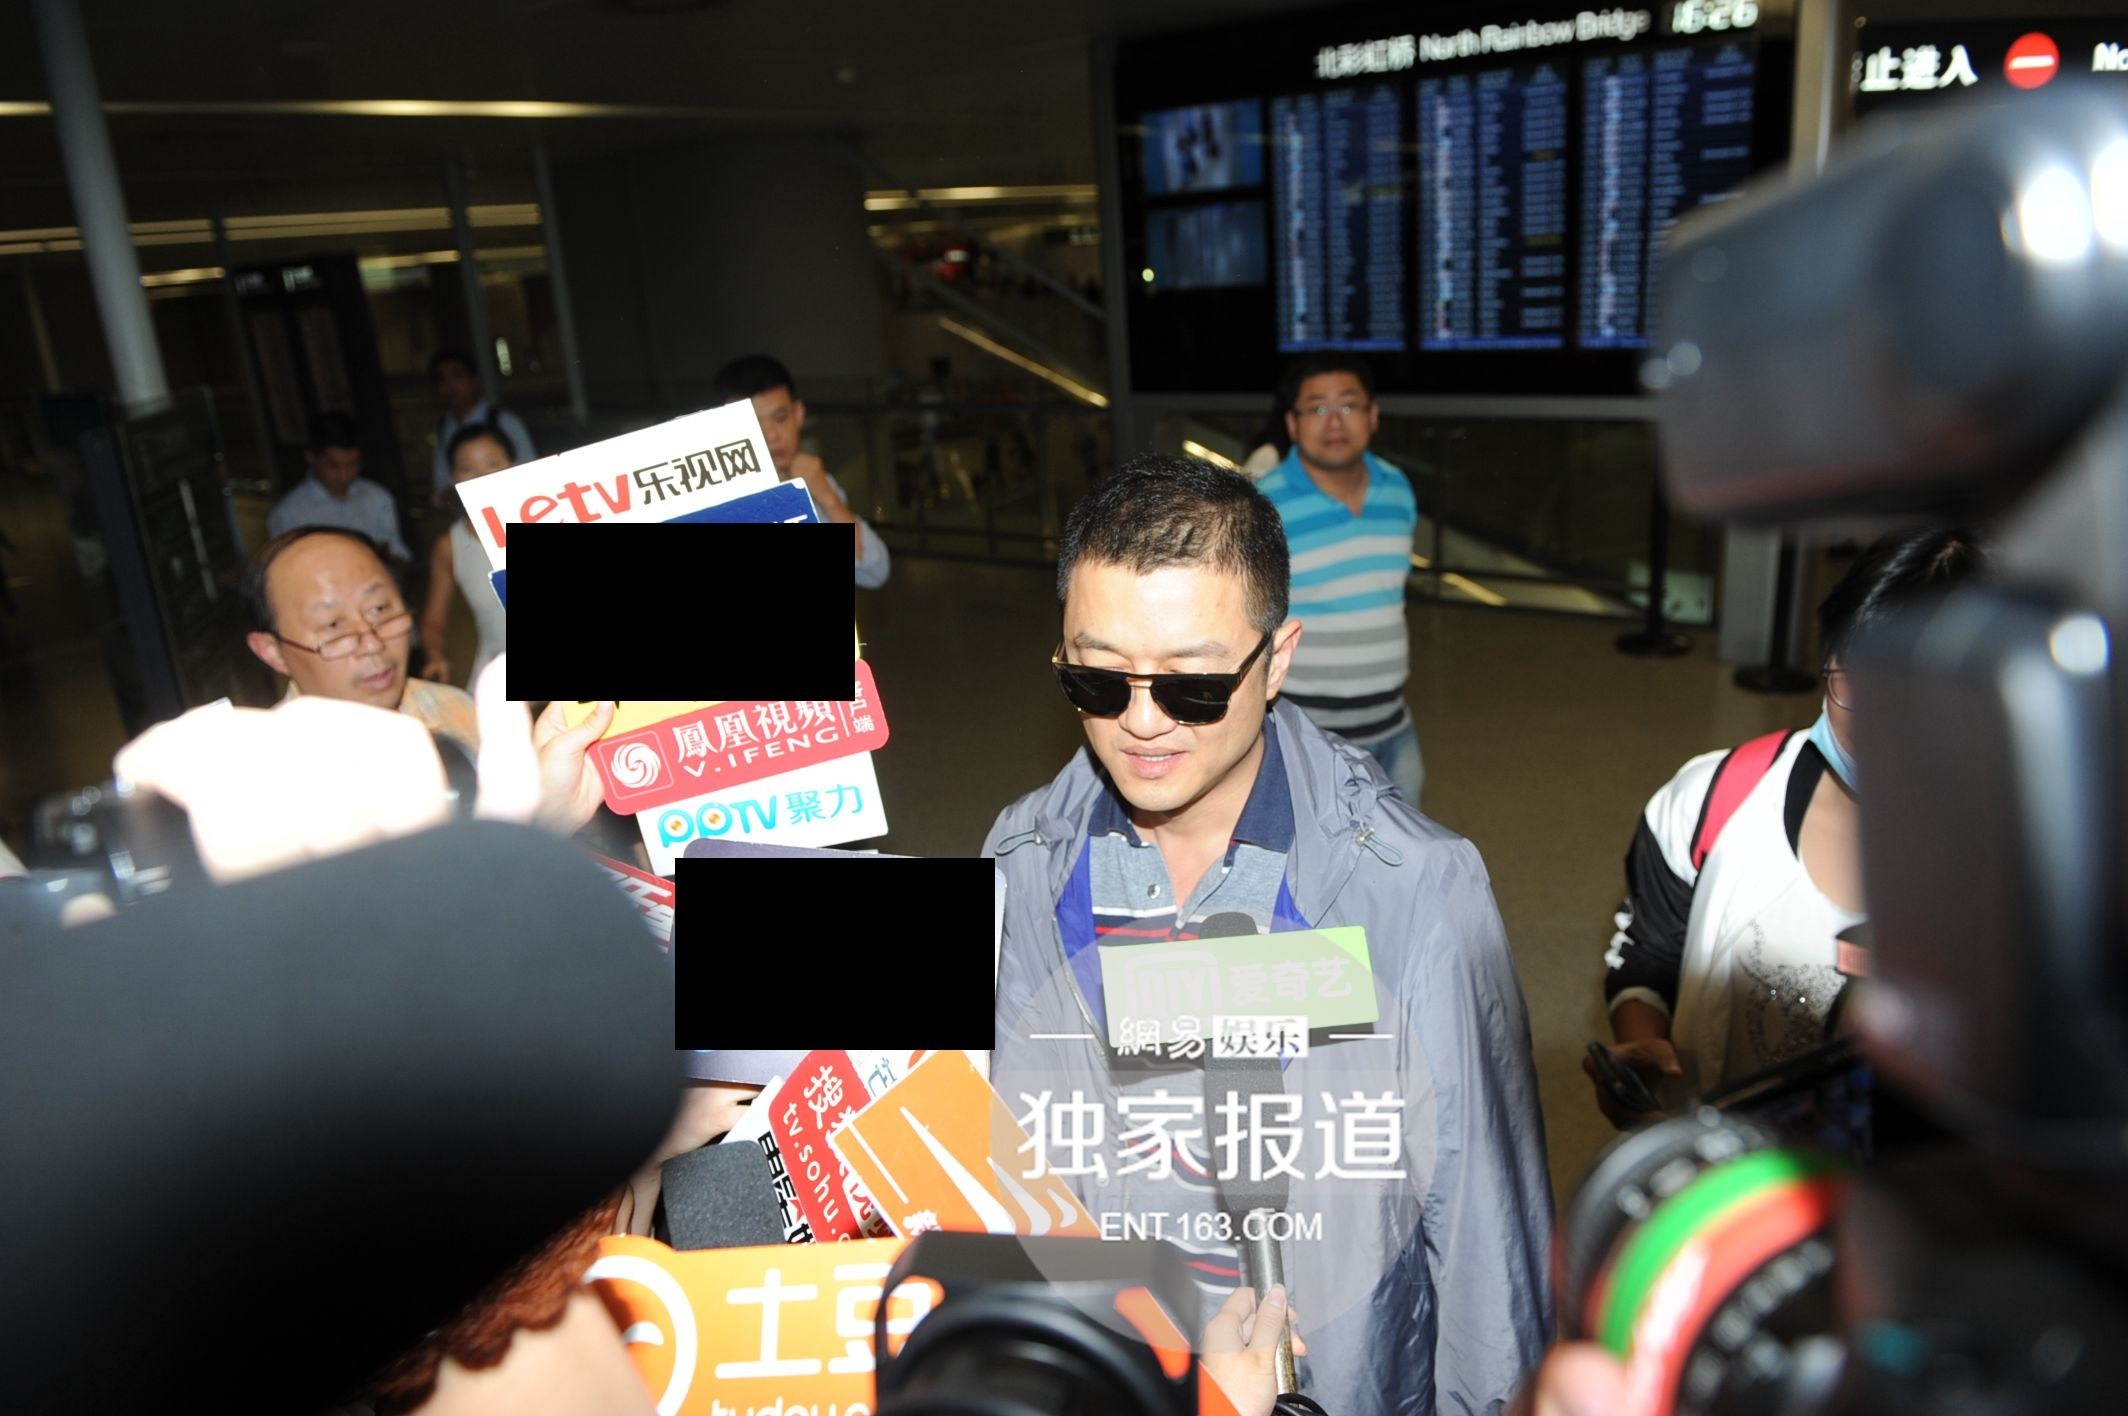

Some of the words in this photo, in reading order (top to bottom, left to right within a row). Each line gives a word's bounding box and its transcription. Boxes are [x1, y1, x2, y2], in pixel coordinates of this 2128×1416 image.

[1419, 28, 1480, 62] North
[1480, 19, 1575, 54] Rainbow
[1575, 7, 1650, 41] Bridge
[1852, 43, 1978, 91] 止进入
[633, 438, 761, 505] 乐视网
[683, 727, 839, 778] V.IFENG
[785, 784, 863, 826] 聚力
[1228, 956, 1353, 1006] 爱奇艺
